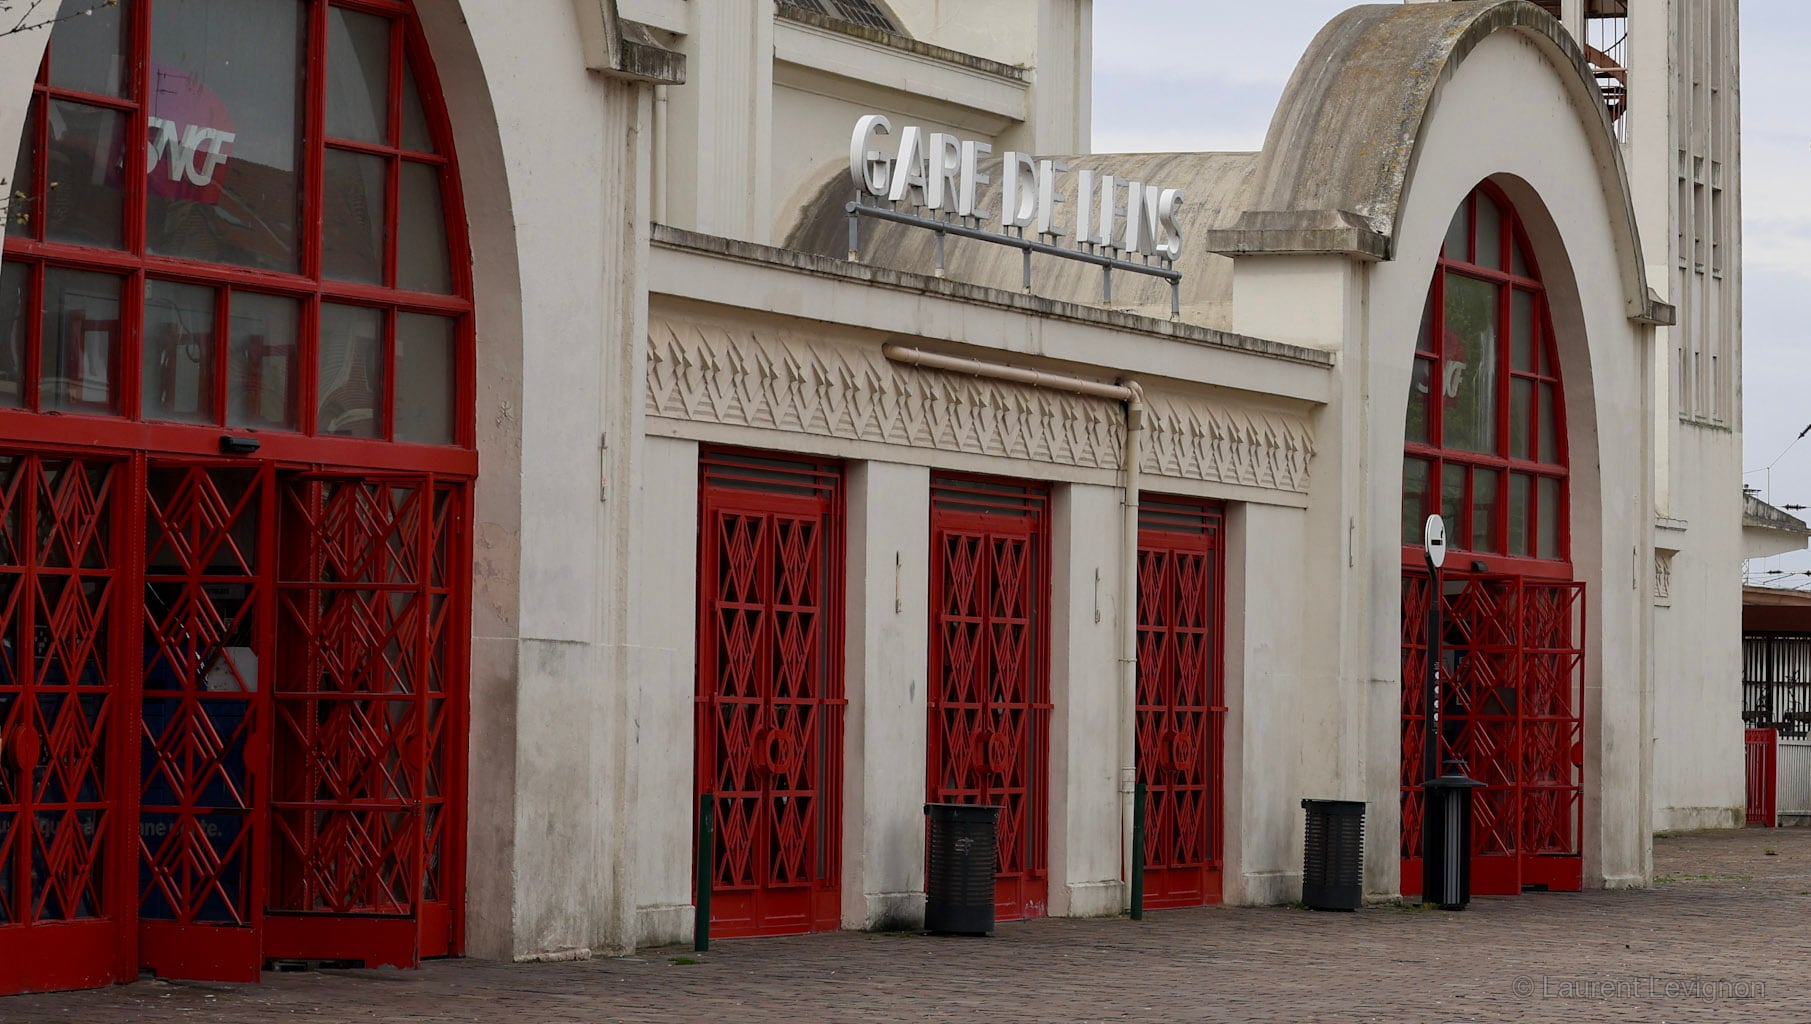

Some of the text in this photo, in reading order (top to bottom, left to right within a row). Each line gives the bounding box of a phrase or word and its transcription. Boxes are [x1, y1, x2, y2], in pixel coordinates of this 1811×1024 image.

[850, 114, 1185, 261] GARE DE LENS
